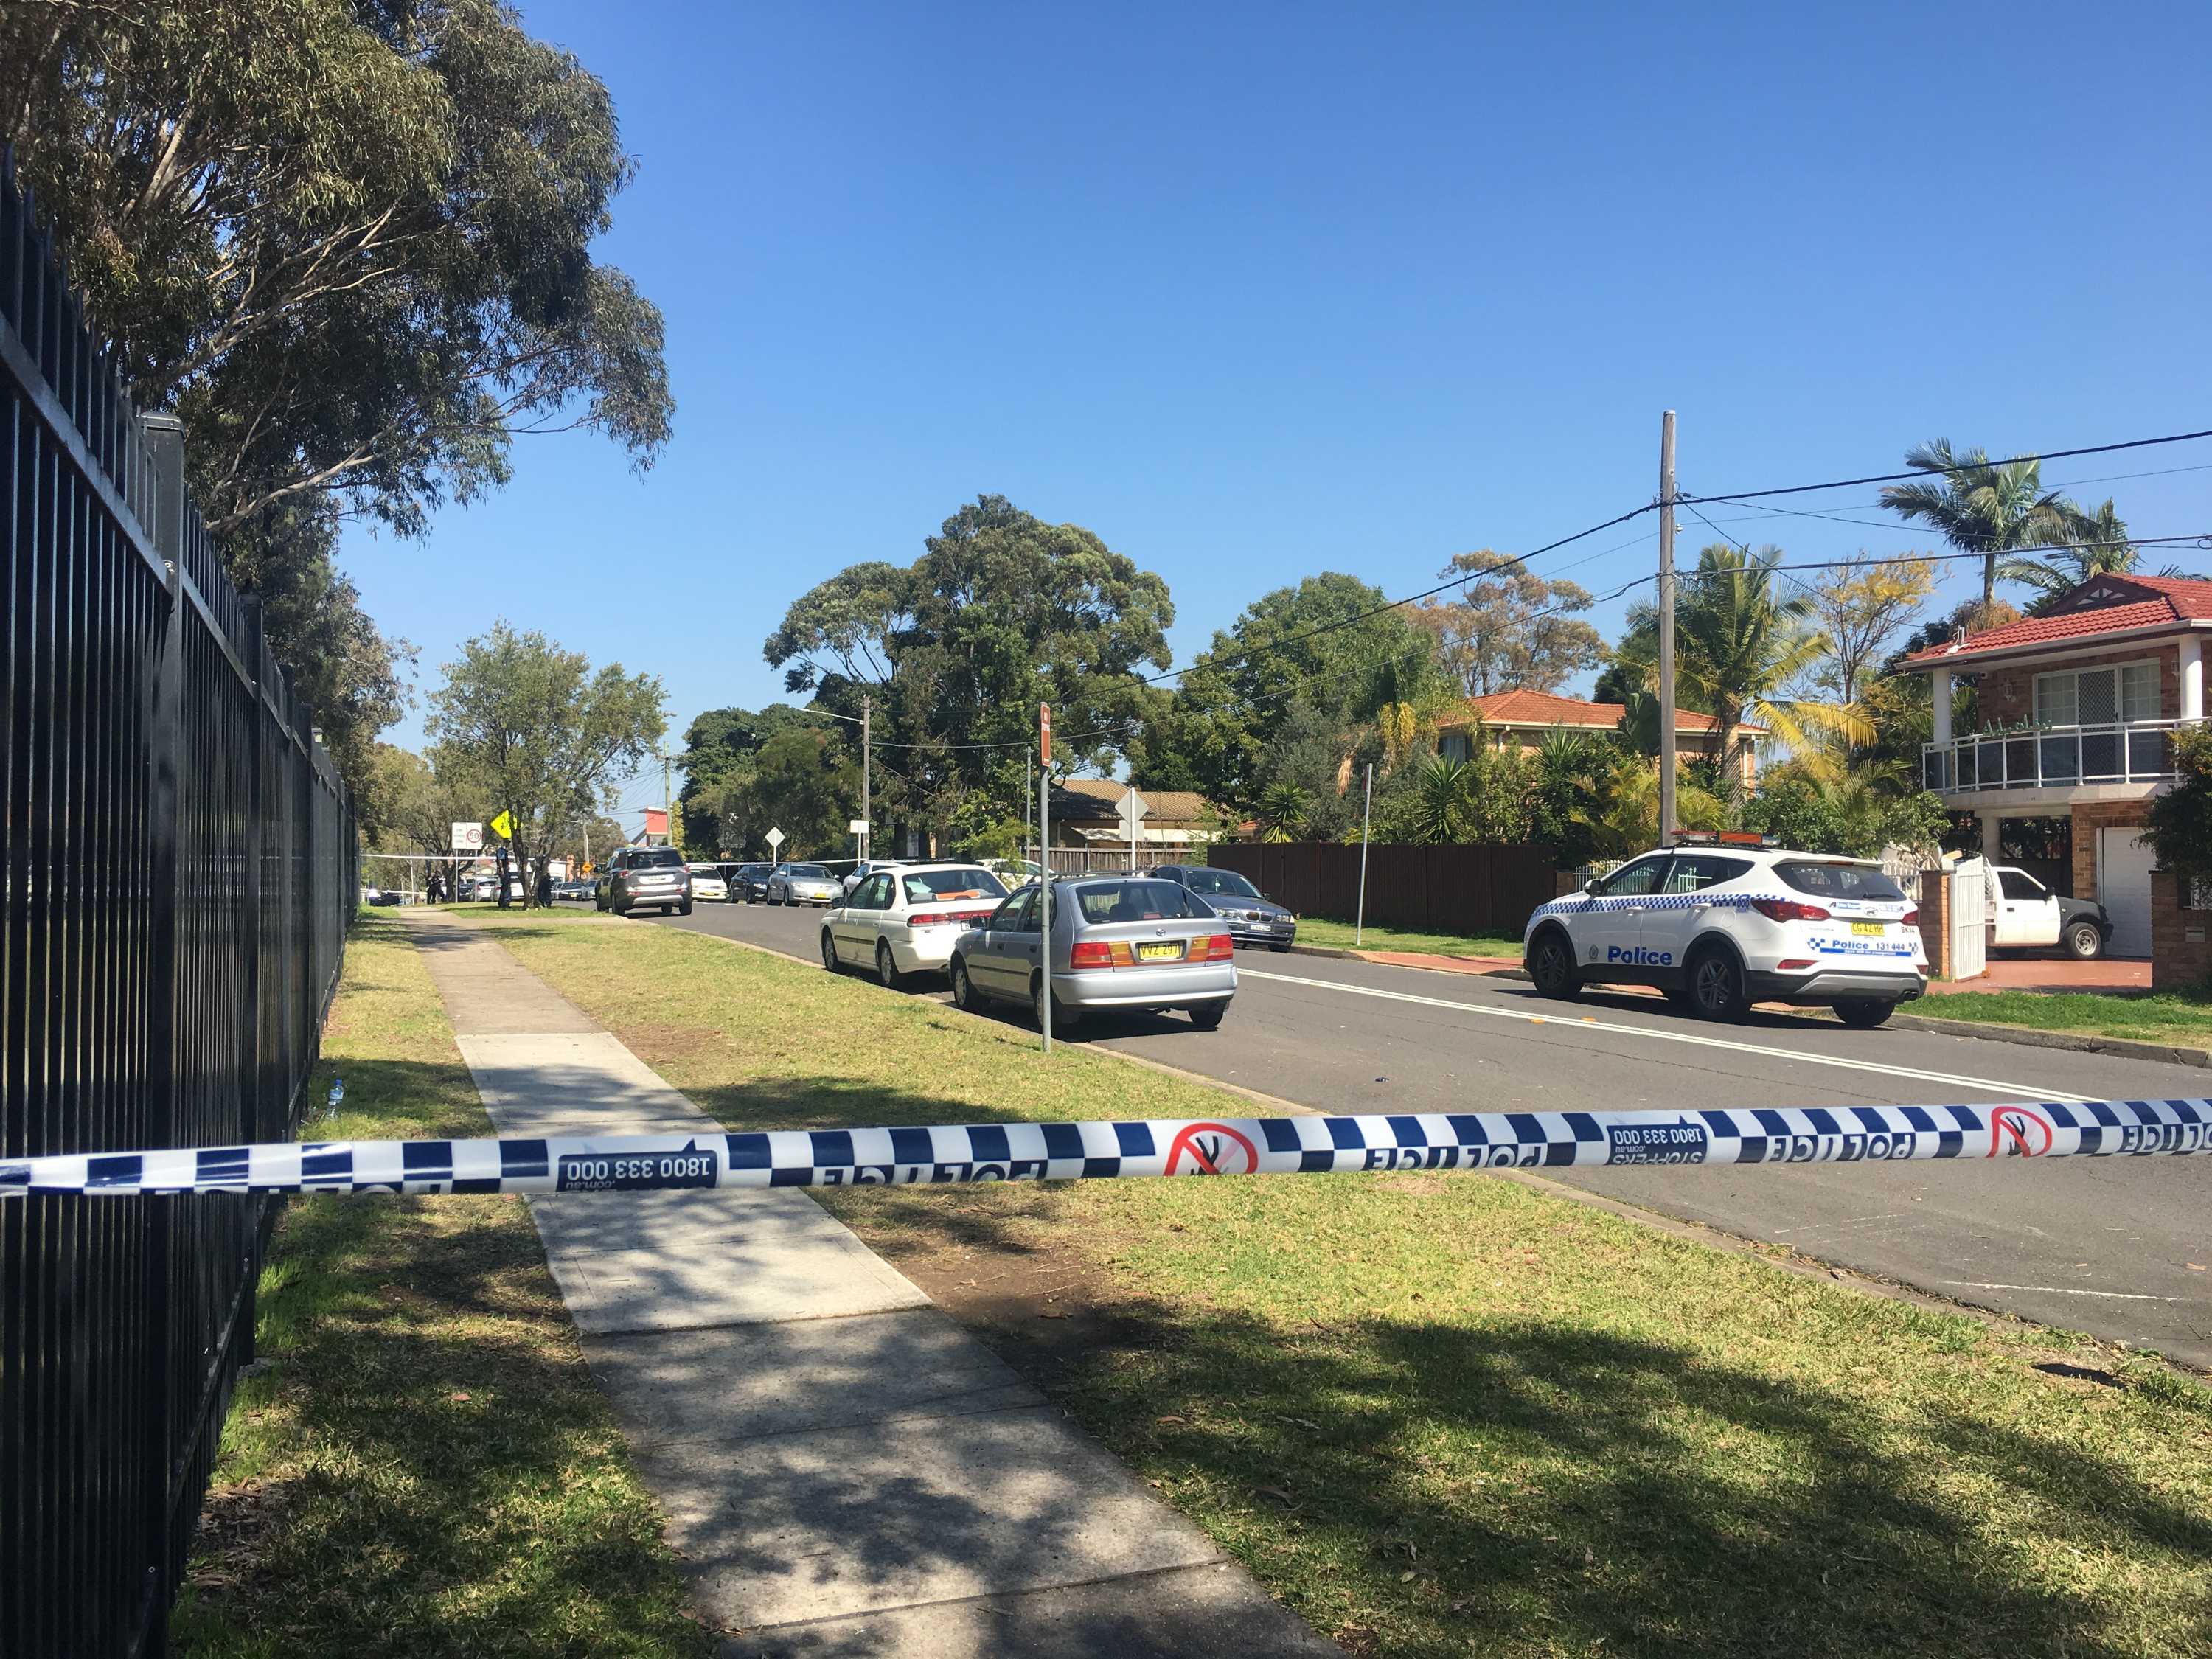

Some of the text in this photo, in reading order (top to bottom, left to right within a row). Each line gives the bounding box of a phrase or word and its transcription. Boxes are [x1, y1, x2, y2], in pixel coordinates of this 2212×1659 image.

[1608, 945, 1672, 966] Police
[1832, 940, 1869, 950] Police
[1876, 942, 1889, 950] 131
[1614, 1127, 1703, 1145] 1800 333 000
[1372, 1146, 1542, 1170] POLICE
[1768, 1135, 1911, 1161] POLICE
[567, 1156, 711, 1181] 1800 333 000
